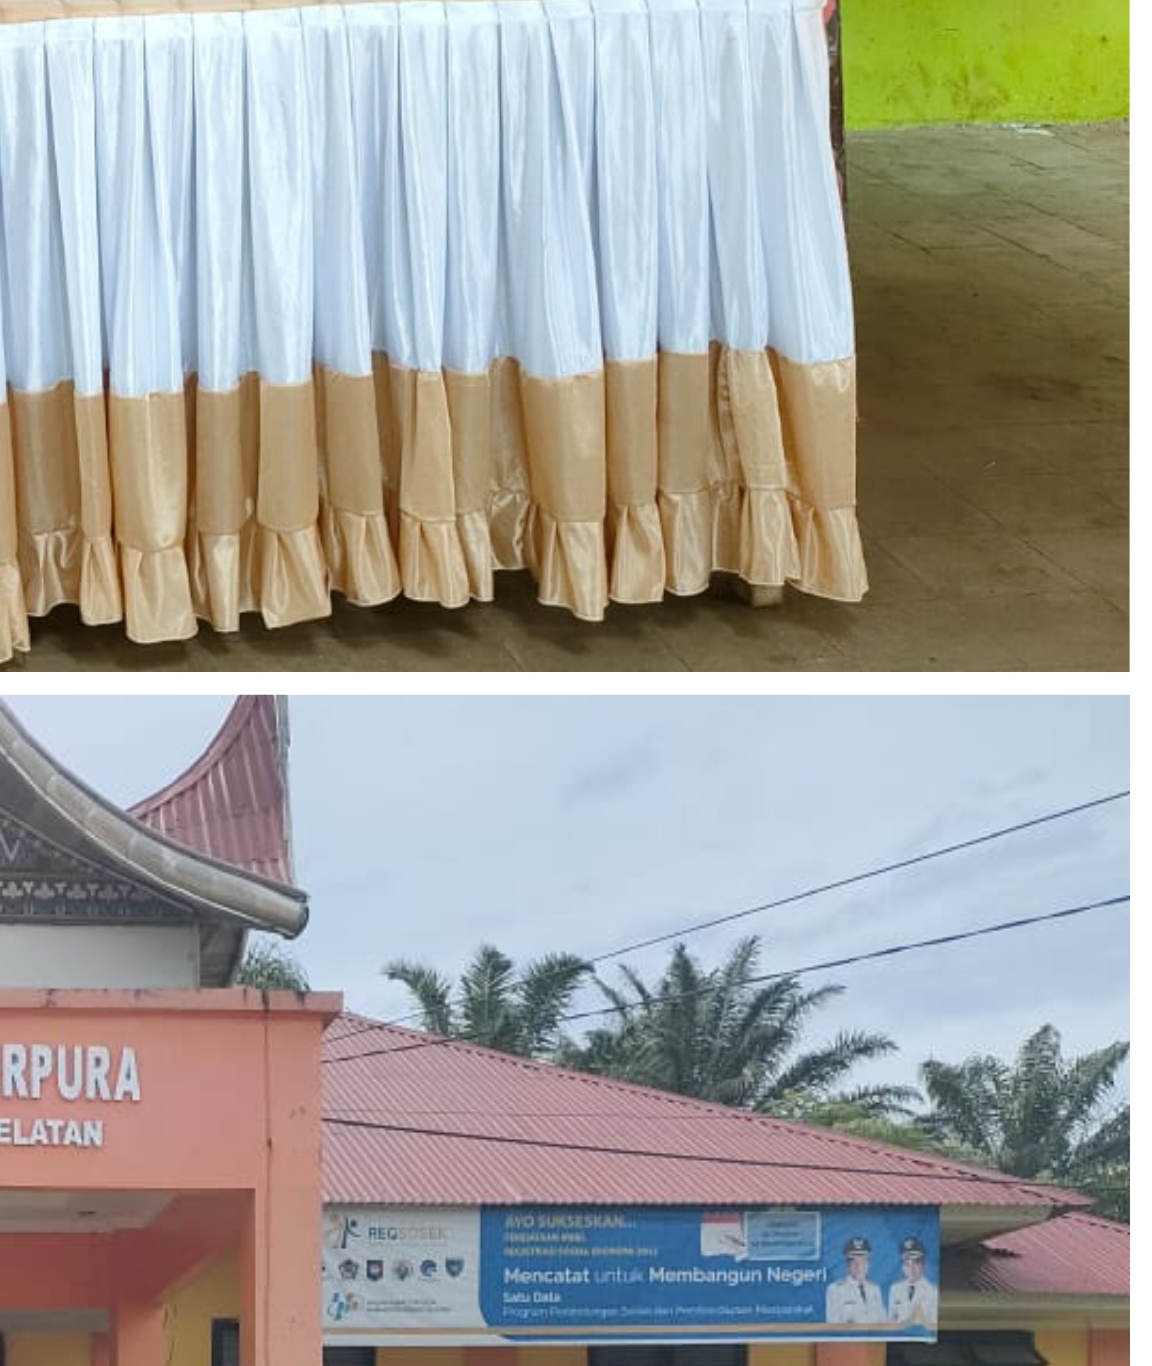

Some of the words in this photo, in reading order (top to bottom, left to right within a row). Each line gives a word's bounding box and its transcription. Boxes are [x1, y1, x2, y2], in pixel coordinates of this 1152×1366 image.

[504, 1267, 590, 1284] Mencatat
[593, 1267, 644, 1284] untuk
[649, 1266, 763, 1287] Membangun
[767, 1266, 828, 1287] Negeri
